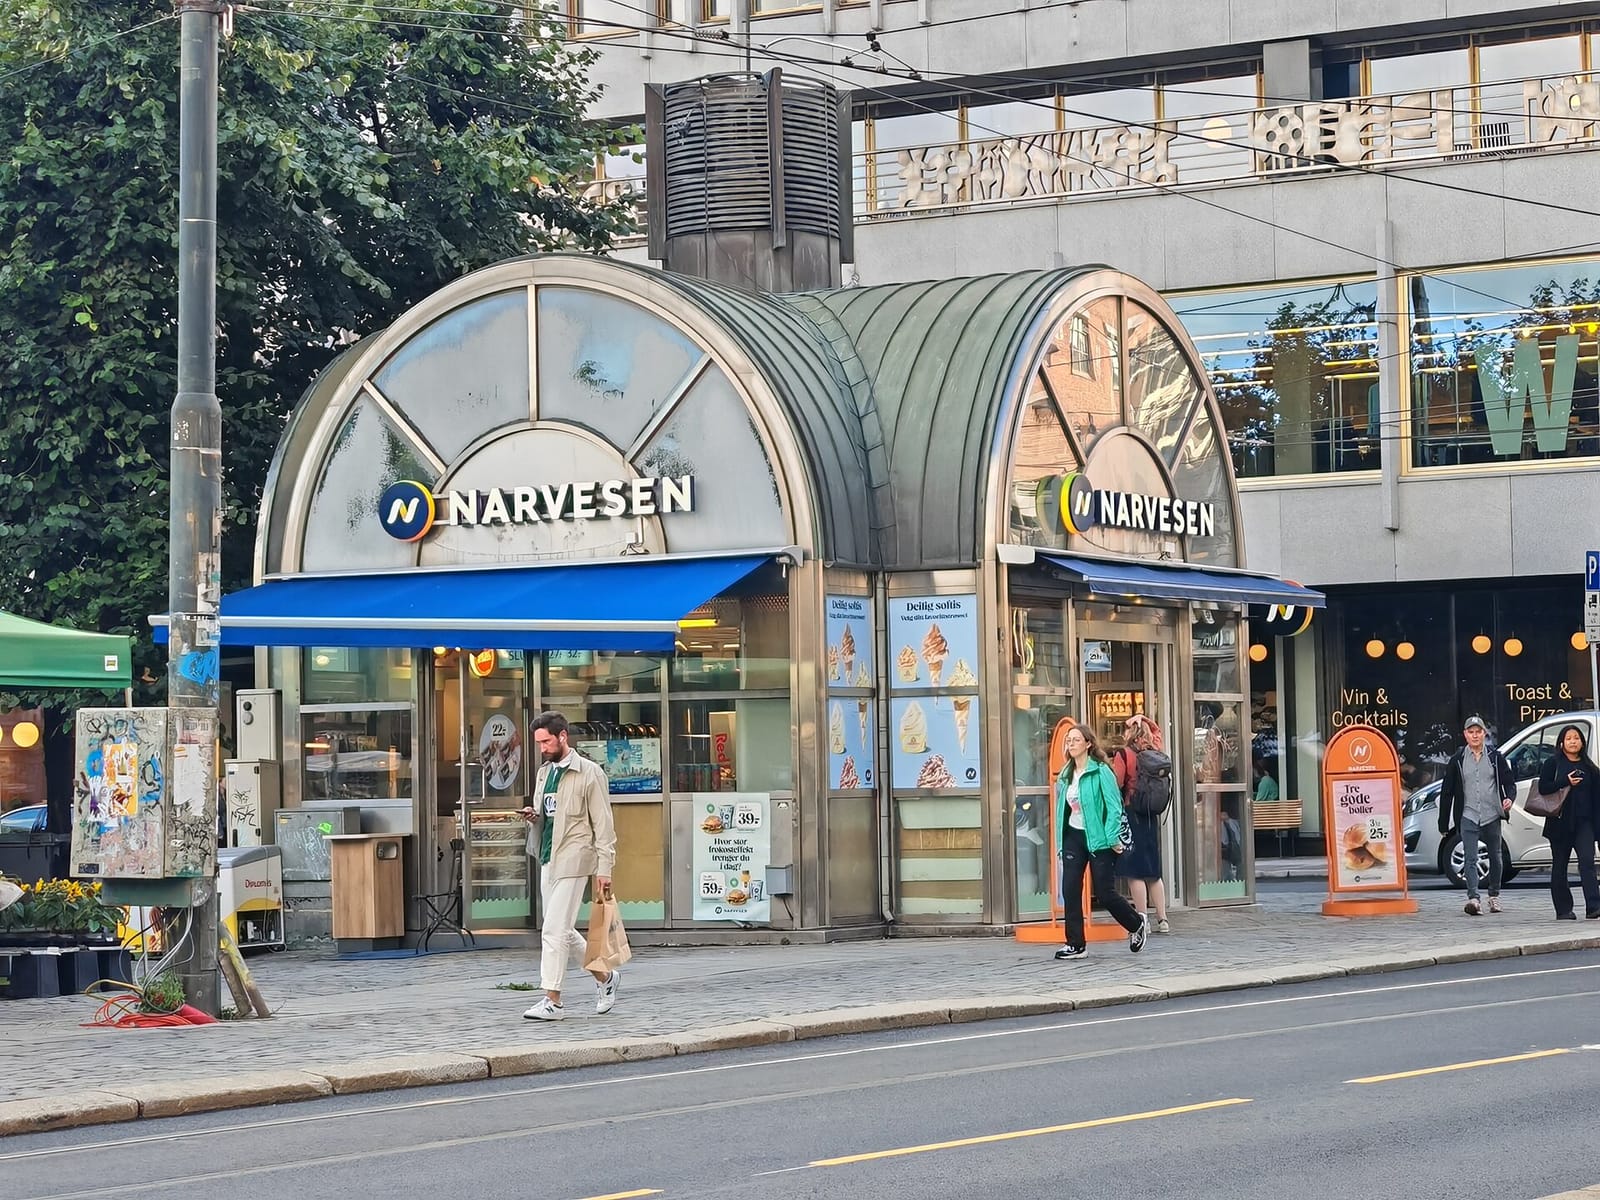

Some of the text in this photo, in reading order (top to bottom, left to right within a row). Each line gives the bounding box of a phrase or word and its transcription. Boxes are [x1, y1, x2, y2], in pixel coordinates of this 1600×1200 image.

[1474, 334, 1580, 455] W
[449, 475, 693, 527] NARVESEN
[1101, 490, 1214, 536] NARVESEN
[1588, 555, 1597, 585] P
[906, 599, 961, 611] Deilig softis
[1343, 688, 1389, 705] Vin &
[1505, 682, 1572, 701] Toast &
[1332, 709, 1408, 727] Cocktails
[715, 733, 731, 762] Red
[1344, 784, 1360, 793] Tre
[1340, 793, 1370, 807] gode
[1349, 806, 1373, 815] boller
